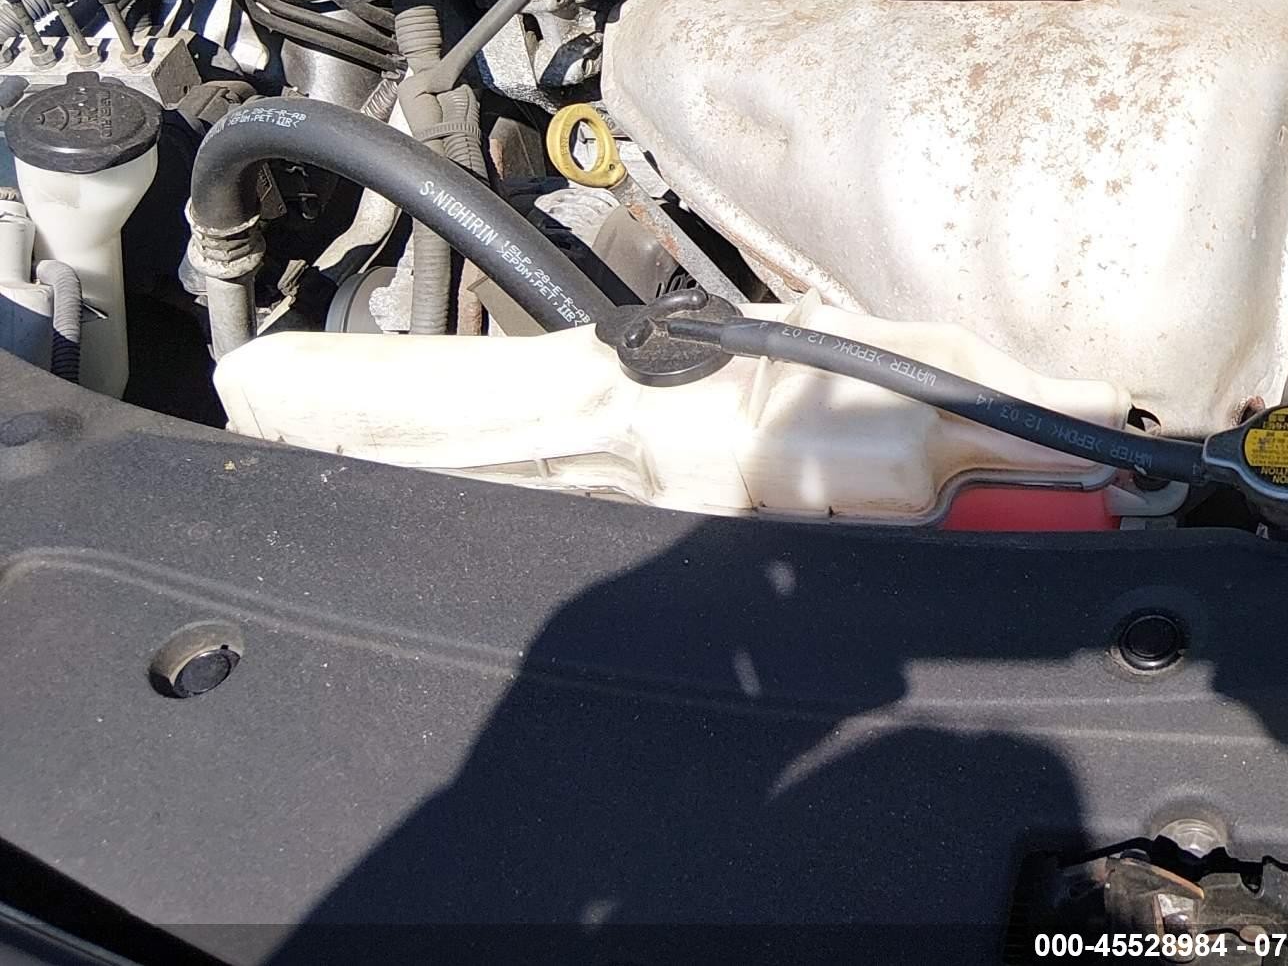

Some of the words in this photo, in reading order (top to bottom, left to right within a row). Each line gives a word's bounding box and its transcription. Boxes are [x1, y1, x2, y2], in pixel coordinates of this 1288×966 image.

[781, 325, 802, 338] 03
[807, 333, 825, 346] 12
[889, 359, 937, 387] WATER
[1023, 414, 1043, 431] 12
[1109, 441, 1153, 467] WATER
